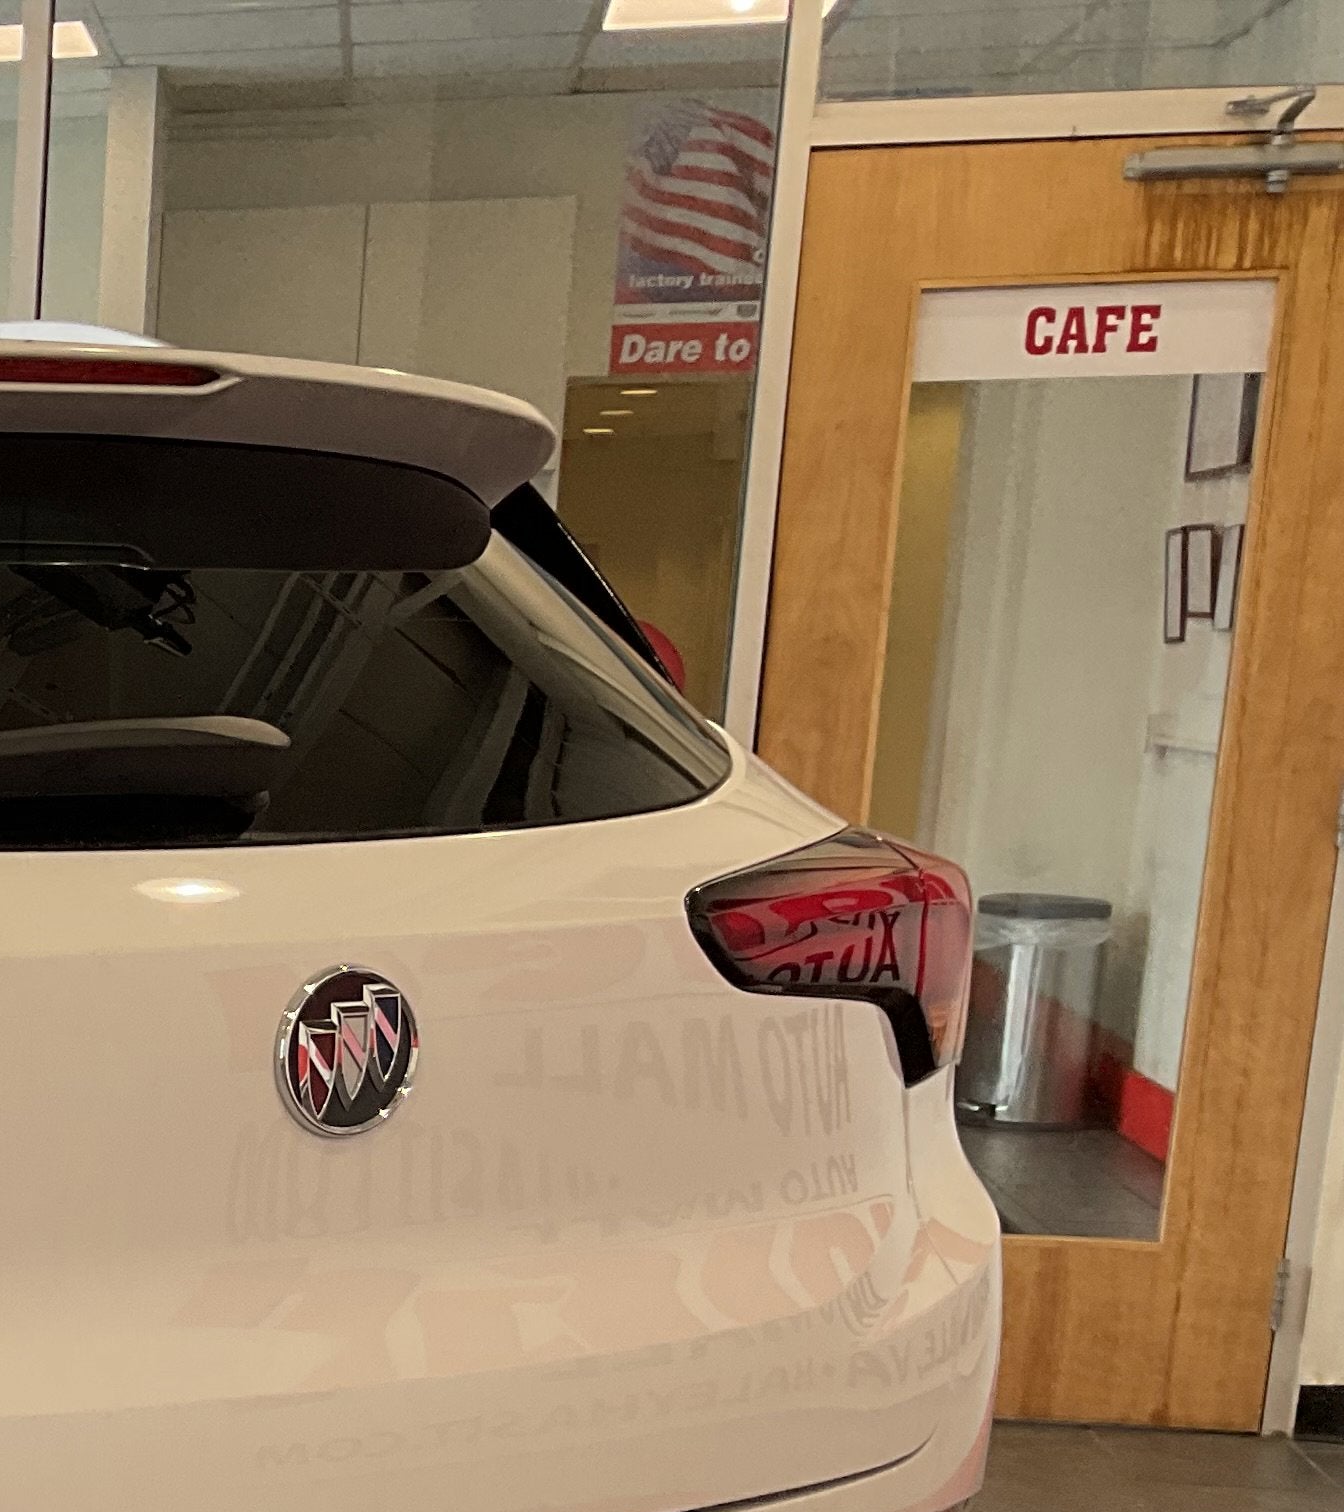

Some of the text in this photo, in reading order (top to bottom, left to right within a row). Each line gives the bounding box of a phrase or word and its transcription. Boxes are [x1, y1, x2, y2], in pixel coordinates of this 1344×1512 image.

[628, 274, 694, 289] factory
[1025, 305, 1162, 355] CAFE
[619, 332, 751, 364] Dare to
